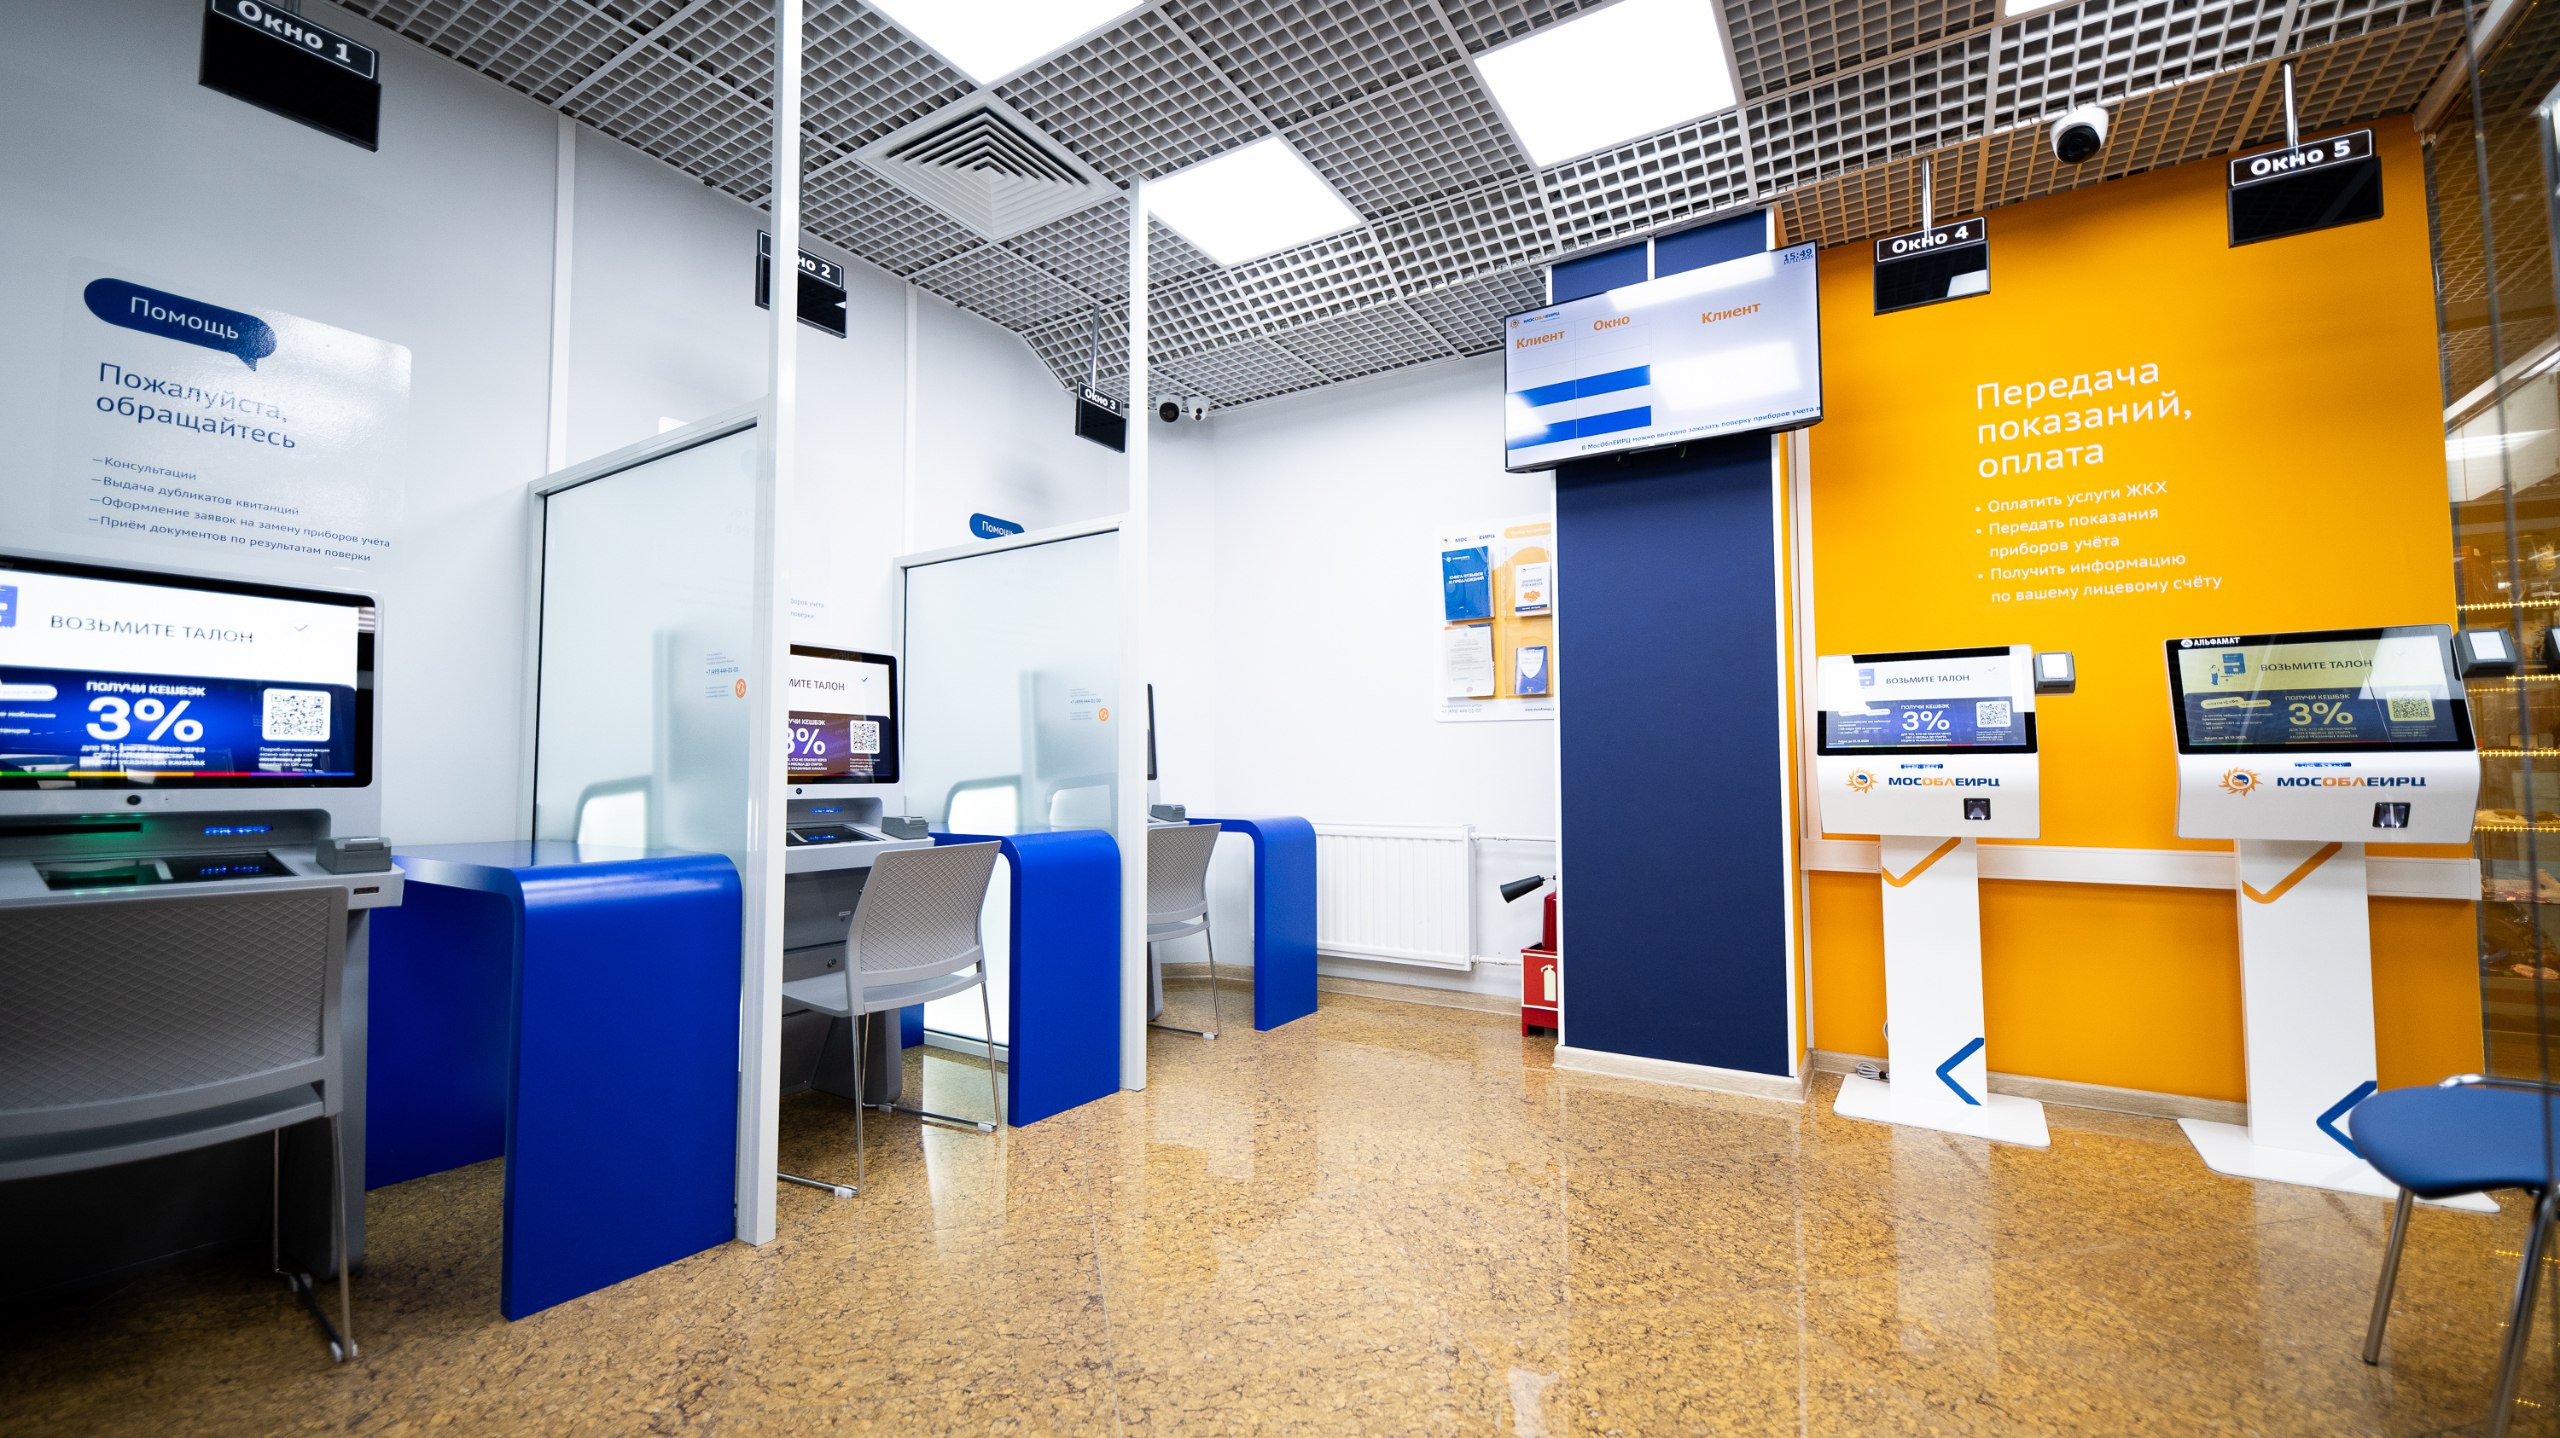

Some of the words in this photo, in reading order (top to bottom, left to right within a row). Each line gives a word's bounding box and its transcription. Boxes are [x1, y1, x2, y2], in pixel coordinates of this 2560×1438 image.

[238, 0, 324, 50] Окно
[335, 43, 351, 63] 1
[2250, 149, 2324, 175] Окно
[2333, 140, 2351, 157] 5
[1892, 233, 1949, 254] Окно
[1954, 225, 1969, 239] 4
[797, 257, 816, 271] но
[821, 264, 831, 278] 2
[1783, 248, 1813, 261] 15:49
[130, 296, 239, 340] Помощь
[1516, 329, 1565, 350] Клиент
[1593, 315, 1630, 332] Окно
[1702, 302, 1761, 324] Клиент
[99, 362, 288, 423] Пожалуйста,
[1085, 388, 1109, 407] Окно
[1109, 400, 1116, 410] 3
[1976, 361, 2159, 410] Передача
[96, 396, 296, 449] обращайтесь
[1632, 434, 1655, 442] можно
[1657, 429, 1686, 439] выгодно
[1689, 423, 1719, 433] заказать
[1721, 417, 1751, 428] поверку
[1753, 411, 1790, 422] приборов
[1792, 406, 1814, 416] учета
[1977, 390, 2192, 444] показаний,
[1978, 442, 2104, 478] оплата
[158, 488, 232, 506] дубликатов
[236, 498, 299, 516] квитанций
[1987, 495, 2062, 513] Оплатить
[2066, 489, 2121, 507] услуги
[2126, 481, 2168, 497] ЖКХ
[194, 510, 236, 525] заявок
[240, 518, 254, 527] на
[258, 521, 301, 536] замену
[303, 526, 358, 547] приборов
[361, 533, 390, 548] учёта
[1988, 518, 2065, 538] Передать
[2069, 507, 2159, 528] показания
[150, 523, 227, 543] документов
[231, 535, 246, 545] по
[250, 537, 321, 556] результатам
[325, 549, 371, 562] поверки
[1989, 540, 2068, 559] приборов
[2073, 535, 2120, 553] учёта
[1990, 563, 2066, 582] Получить
[2070, 553, 2186, 574] информацию
[1991, 591, 2011, 603] по
[2015, 584, 2079, 602] вашему
[2082, 579, 2169, 597] лицевому
[2173, 575, 2223, 591] счёту
[50, 614, 175, 639] ВОЗЬМИТЕ
[182, 626, 254, 644] ТАЛОН
[2193, 636, 2241, 648] АЛЬФАМАТ
[1886, 675, 1935, 685] ВОЗЬМИТЕ
[1937, 674, 1970, 683] ТАЛОН
[2260, 661, 2327, 673] ВОЗЬМИТЕ
[2329, 659, 2373, 671] ТАЛОН
[86, 681, 146, 694] ПОЛУЧИ
[150, 685, 206, 697] КЕШБЭК
[814, 680, 845, 691] ТАЛОН
[86, 696, 205, 742] 3%
[1902, 710, 1950, 731] 3%
[2288, 702, 2353, 725] 3%
[1888, 776, 2000, 787] МОСОБЛЕИРЦ
[2277, 776, 2426, 787] МОСОБЛЕИРЦ
